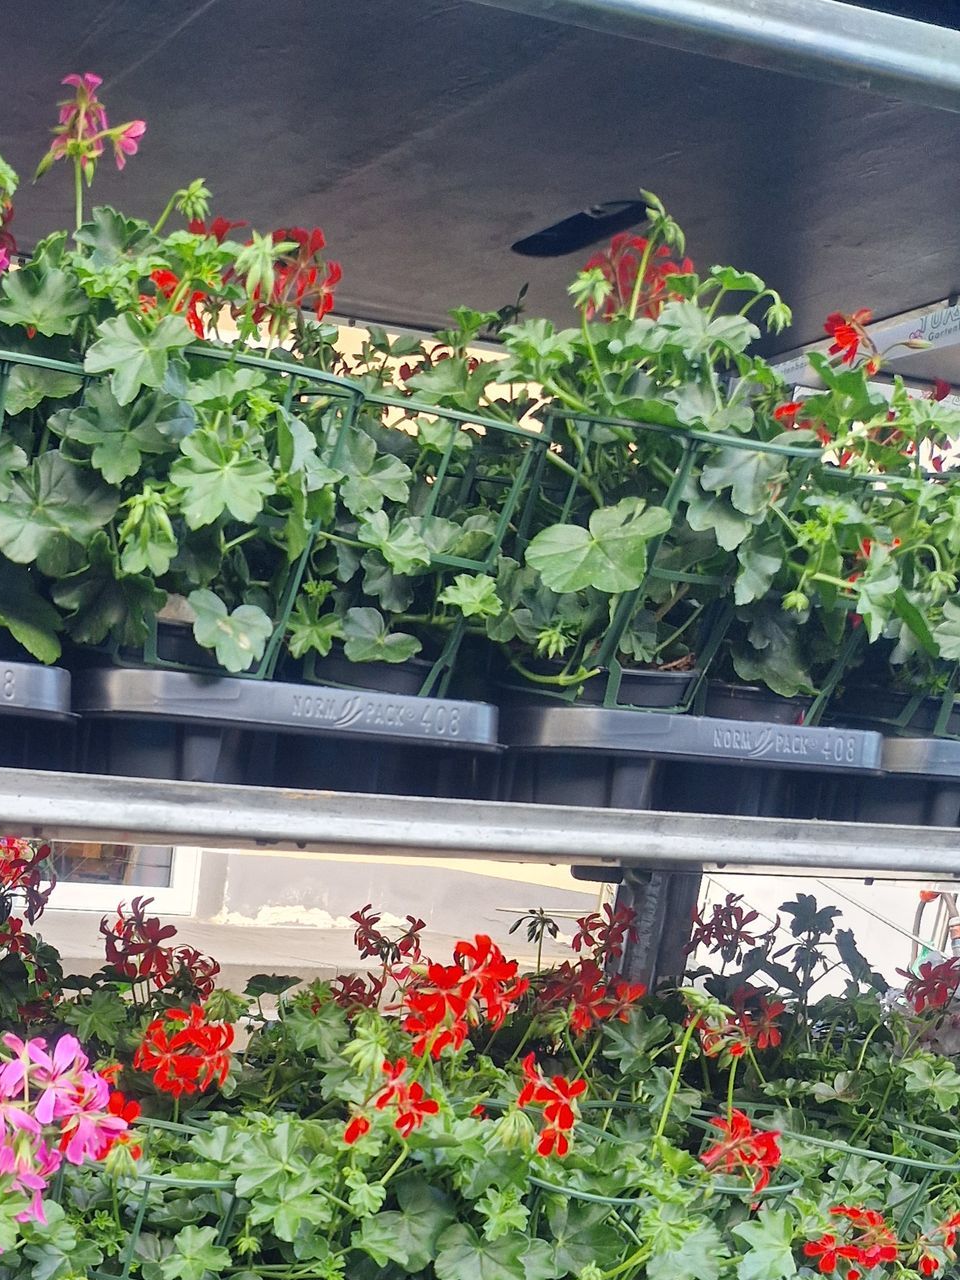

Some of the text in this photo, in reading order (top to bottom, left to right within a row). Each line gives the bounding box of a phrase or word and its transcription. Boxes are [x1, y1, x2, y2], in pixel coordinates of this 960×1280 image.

[292, 695, 338, 721] NORM
[420, 704, 461, 736] 408
[713, 728, 752, 751] NORM
[821, 734, 855, 763] 408
